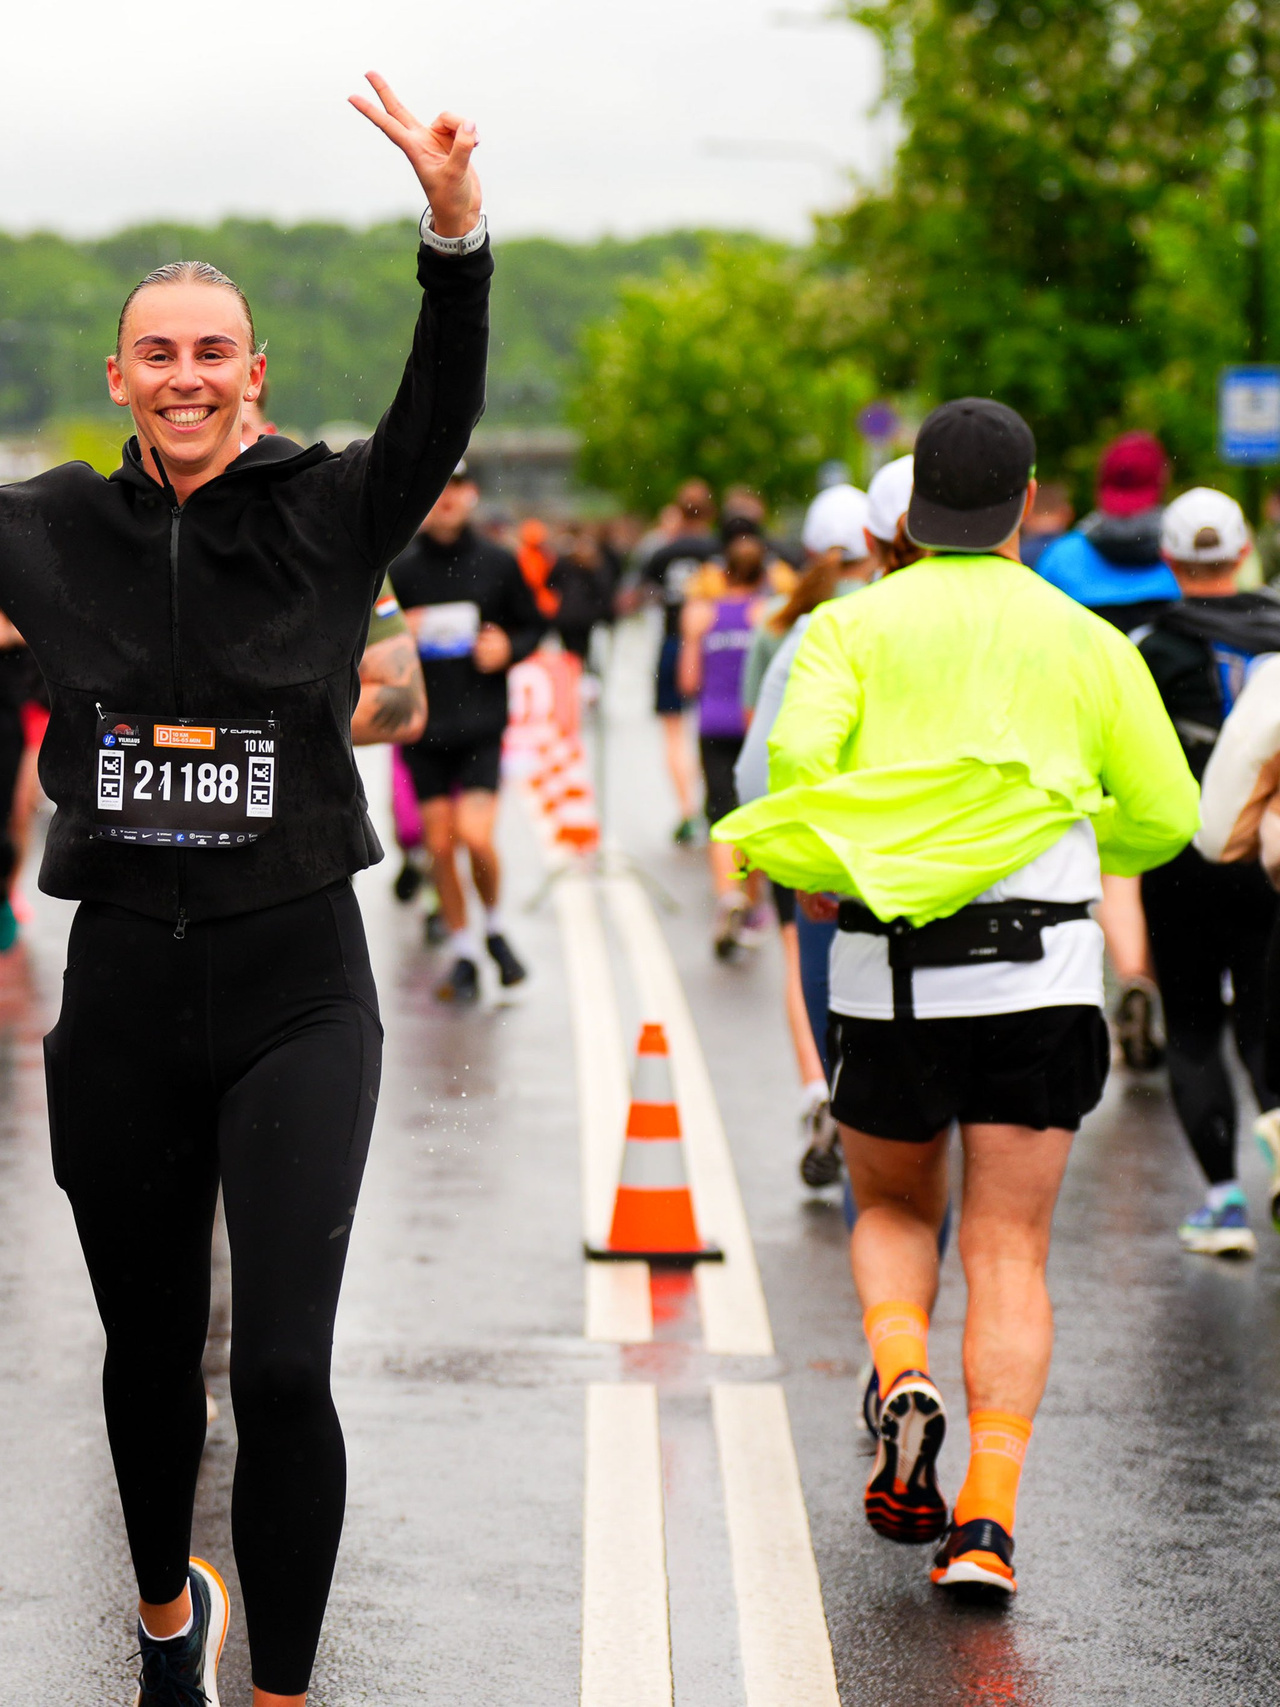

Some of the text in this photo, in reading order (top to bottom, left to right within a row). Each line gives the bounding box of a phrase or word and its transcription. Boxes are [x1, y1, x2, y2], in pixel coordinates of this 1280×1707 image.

[159, 730, 169, 742] D
[244, 739, 275, 754] 10 KM
[133, 759, 240, 804] 21188
